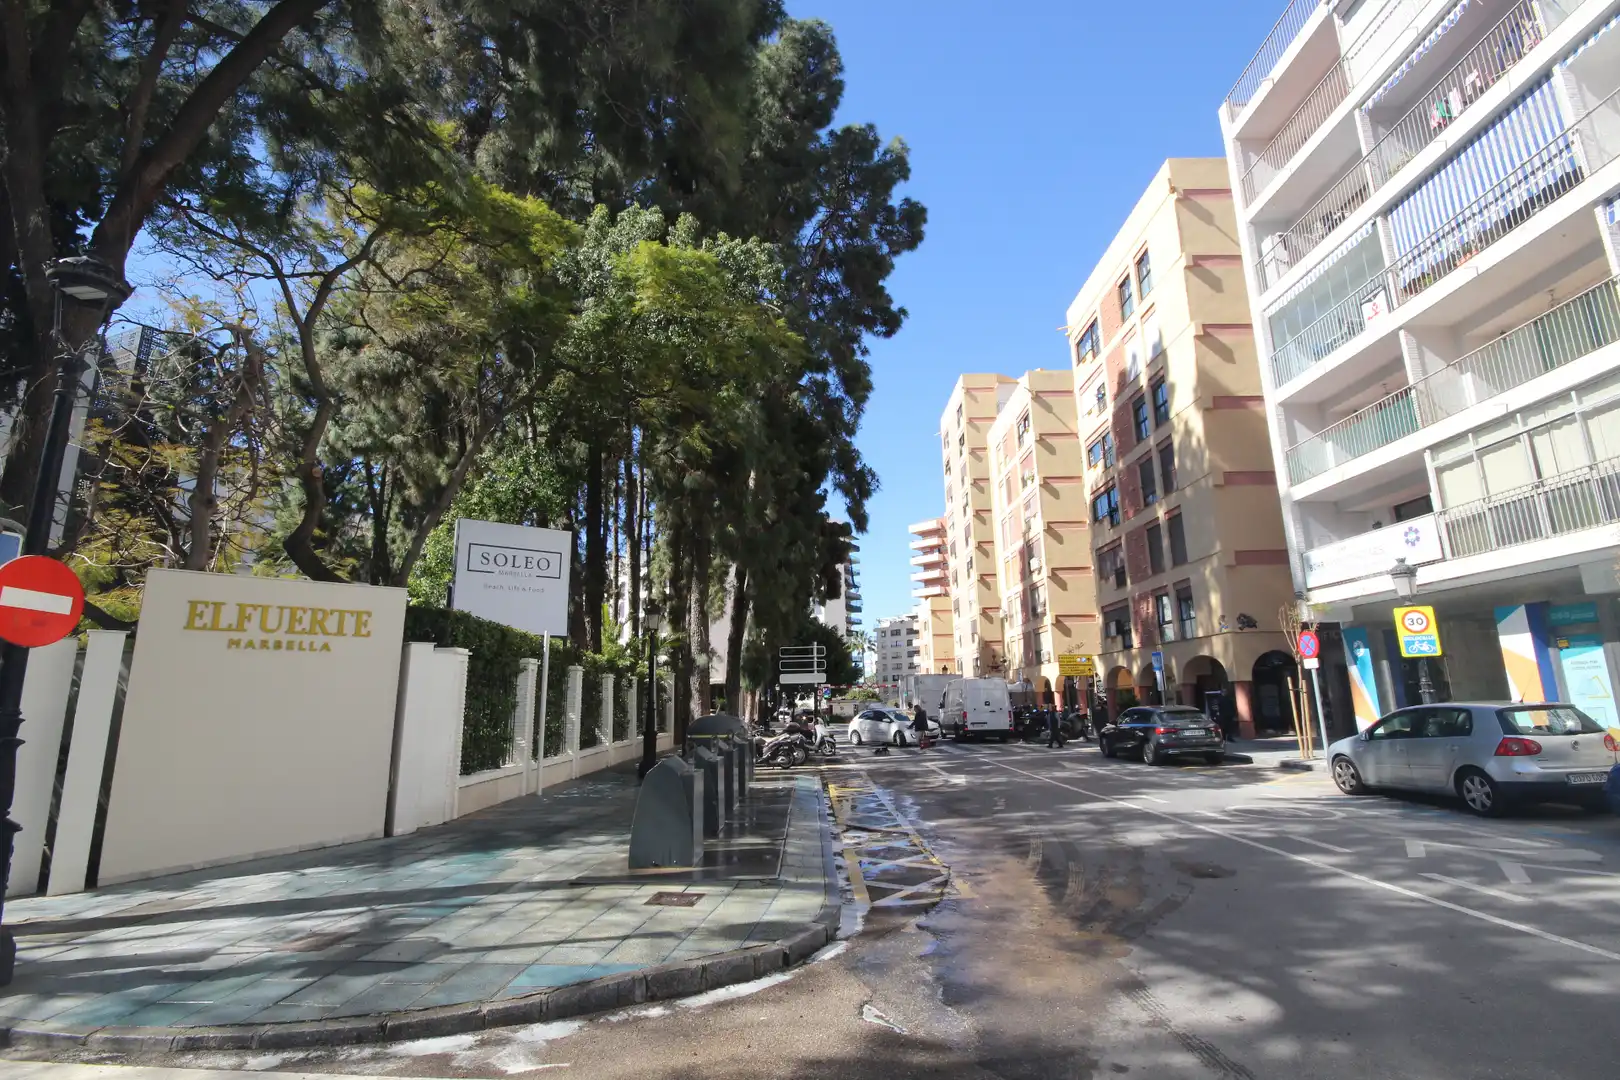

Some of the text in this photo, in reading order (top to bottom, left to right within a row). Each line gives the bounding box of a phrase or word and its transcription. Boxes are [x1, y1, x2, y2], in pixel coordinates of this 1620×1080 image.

[480, 552, 550, 571] SOLEO
[498, 569, 532, 578] MARBELLA
[1407, 617, 1424, 627] 30
[227, 638, 332, 652] MARBELLA
